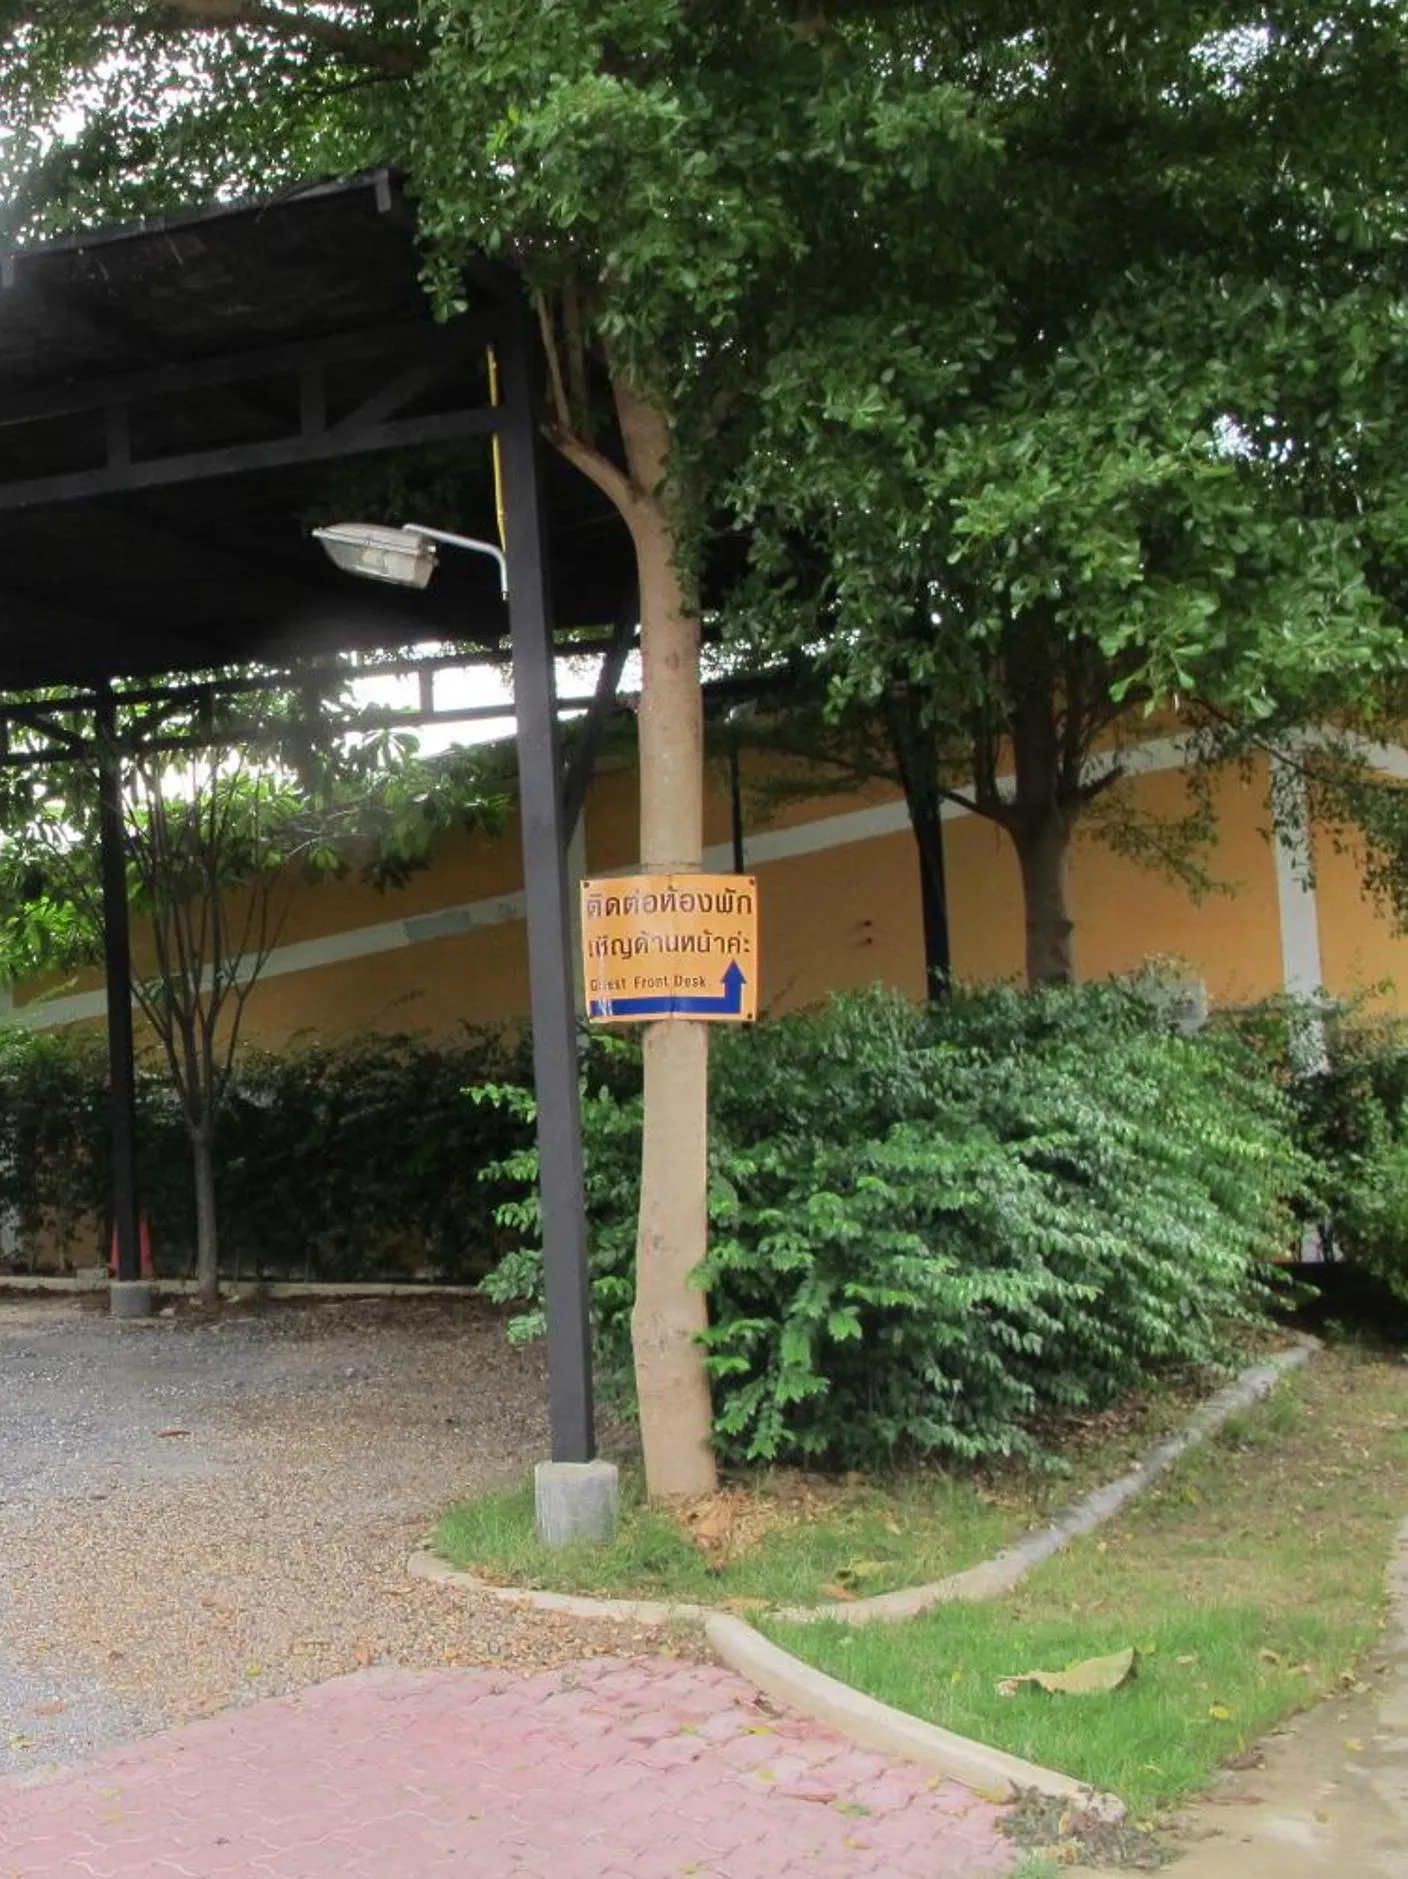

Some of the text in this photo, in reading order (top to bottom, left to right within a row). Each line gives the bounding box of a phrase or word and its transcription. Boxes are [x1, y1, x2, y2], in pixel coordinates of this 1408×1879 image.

[586, 885, 752, 917] ติดต่อห้องพัก
[634, 976, 668, 989] Front
[673, 974, 706, 988] Desk
